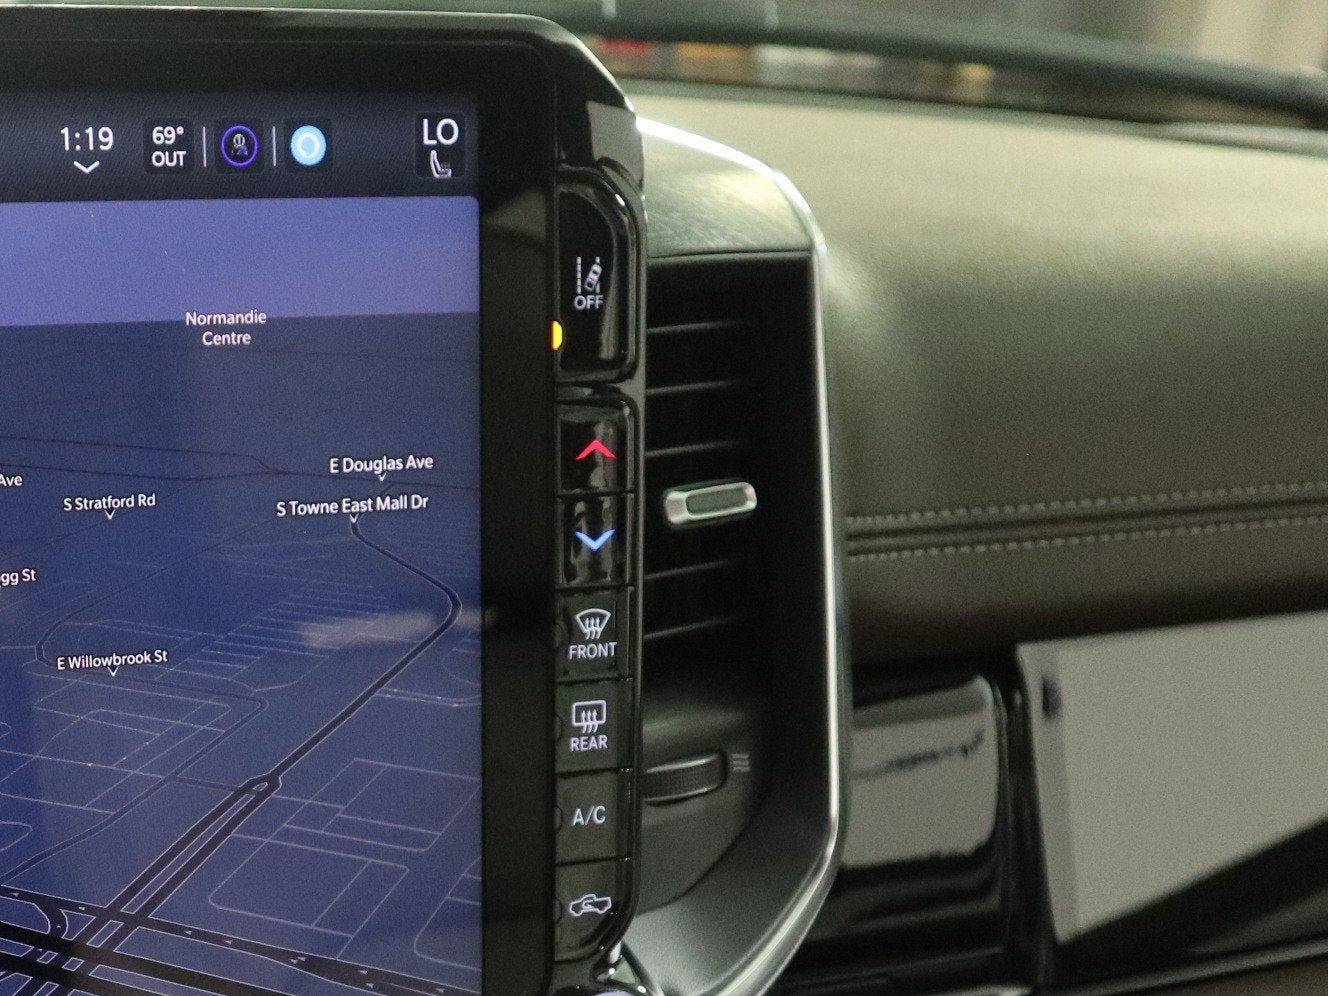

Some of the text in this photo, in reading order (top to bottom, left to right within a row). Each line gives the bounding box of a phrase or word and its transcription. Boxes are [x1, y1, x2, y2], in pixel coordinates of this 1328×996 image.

[59, 126, 114, 151] 1:19
[423, 118, 459, 145] LO
[151, 151, 186, 167] OUT
[574, 295, 604, 311] OFF
[185, 310, 267, 326] Normandie
[201, 330, 252, 346] Centre
[330, 455, 434, 474] E Douglas Ave
[63, 494, 156, 511] S Stratford Rd
[276, 495, 429, 517] S Towne East Mall Dr
[21, 569, 36, 582] St
[569, 642, 617, 660] FRONT
[57, 650, 168, 670] E Willowbrook St
[571, 735, 608, 752] REAR
[573, 806, 606, 826] A/C
